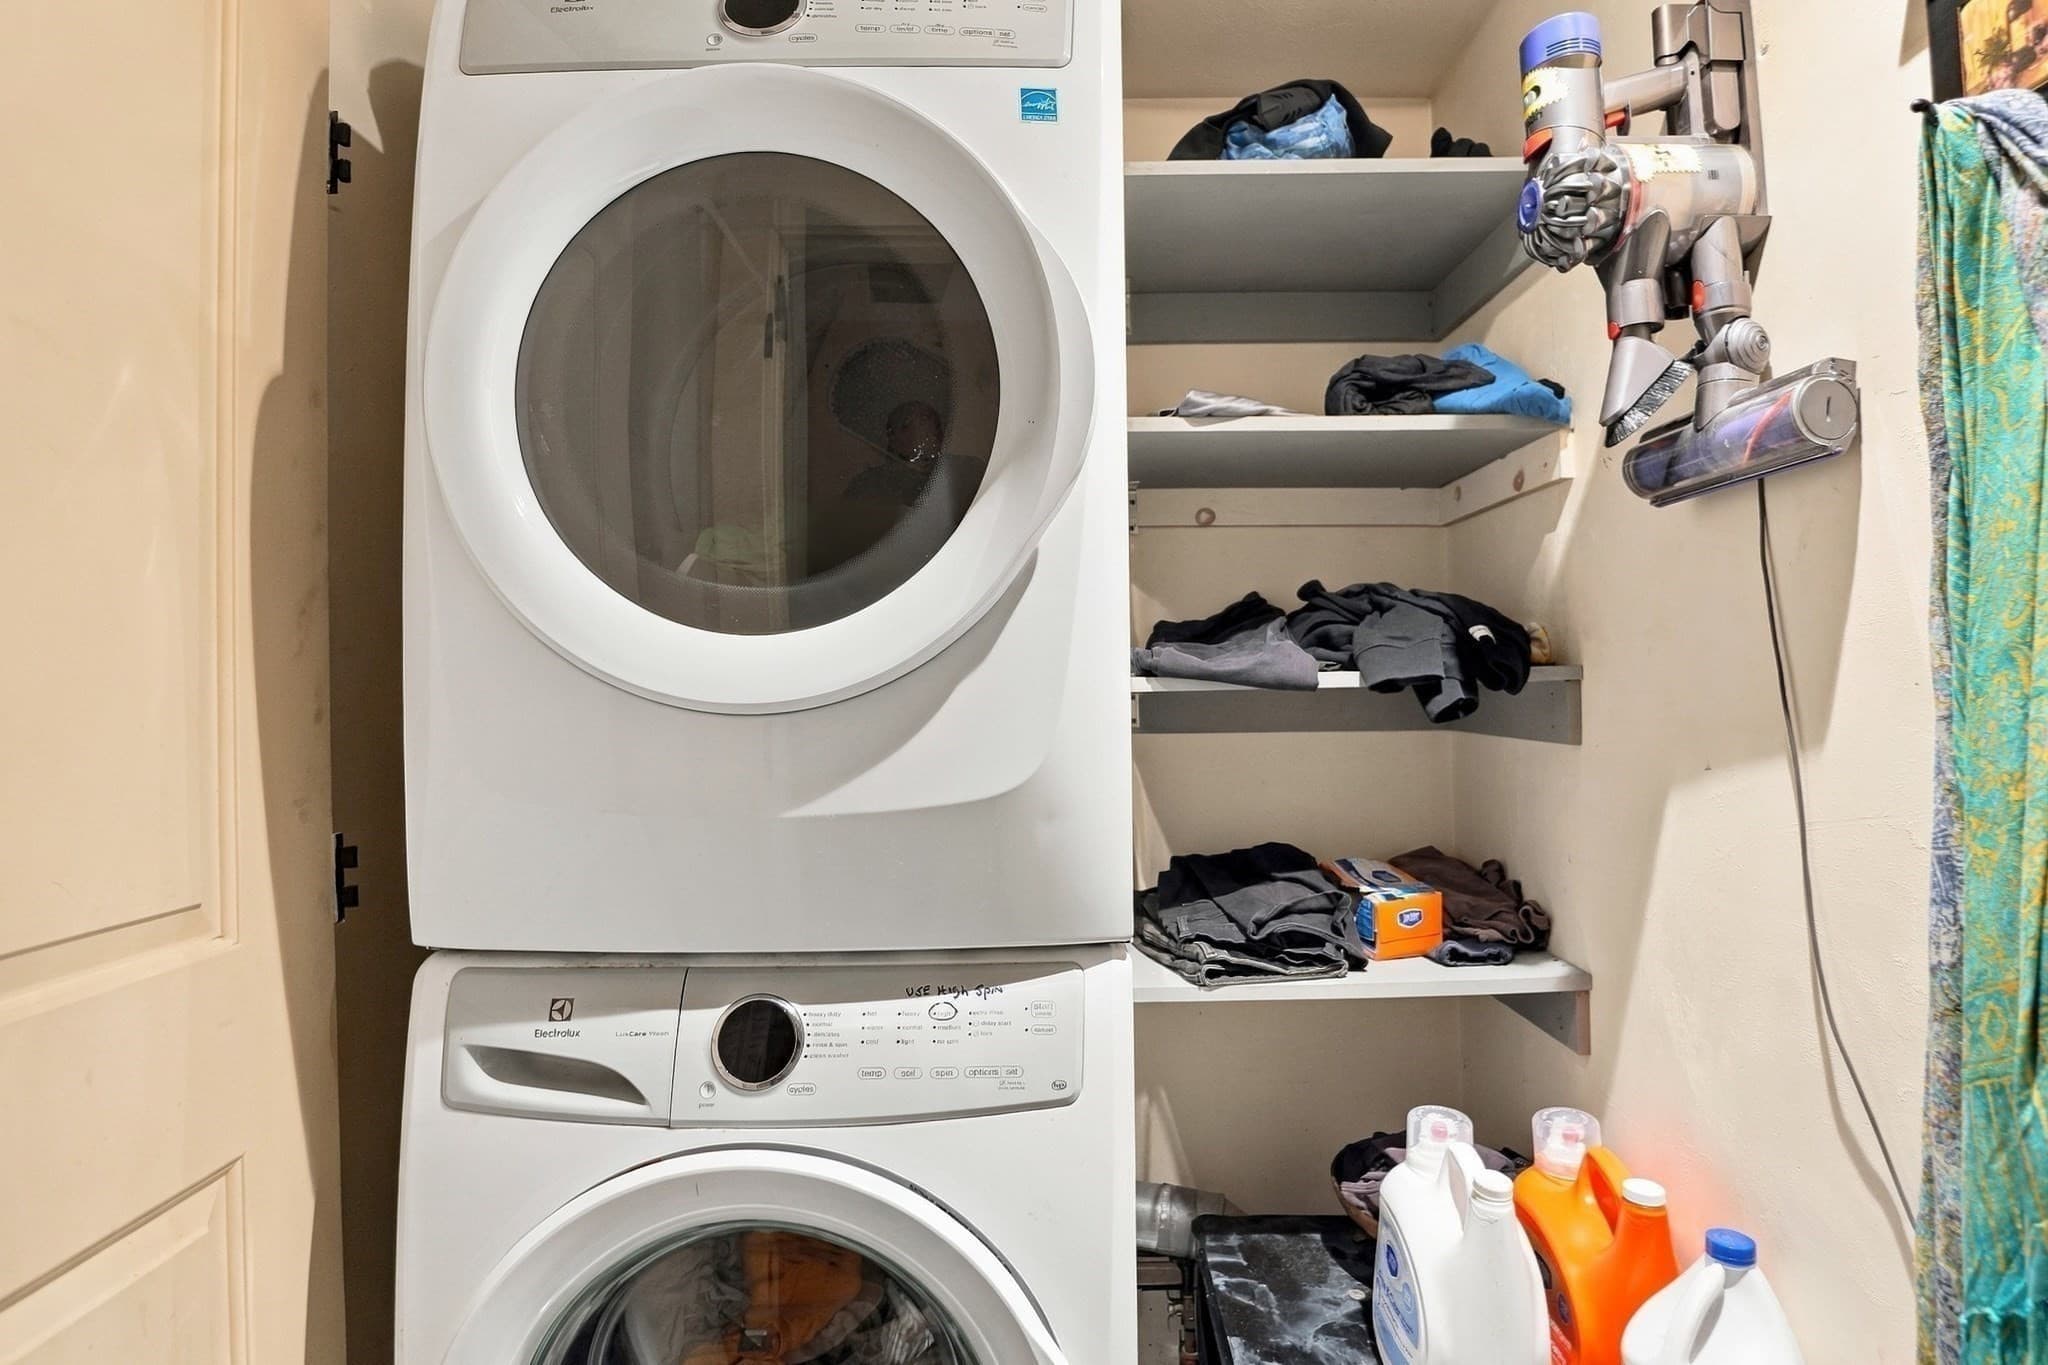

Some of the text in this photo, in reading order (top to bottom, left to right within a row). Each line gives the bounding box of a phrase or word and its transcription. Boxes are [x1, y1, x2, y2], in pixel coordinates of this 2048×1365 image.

[905, 985, 931, 997] USE
[534, 1028, 581, 1039] Electrolux
[861, 1069, 882, 1078] temp
[901, 1069, 916, 1077] soil
[935, 1069, 953, 1078] spin
[968, 1067, 999, 1077] options
[789, 1085, 814, 1094] cycles
